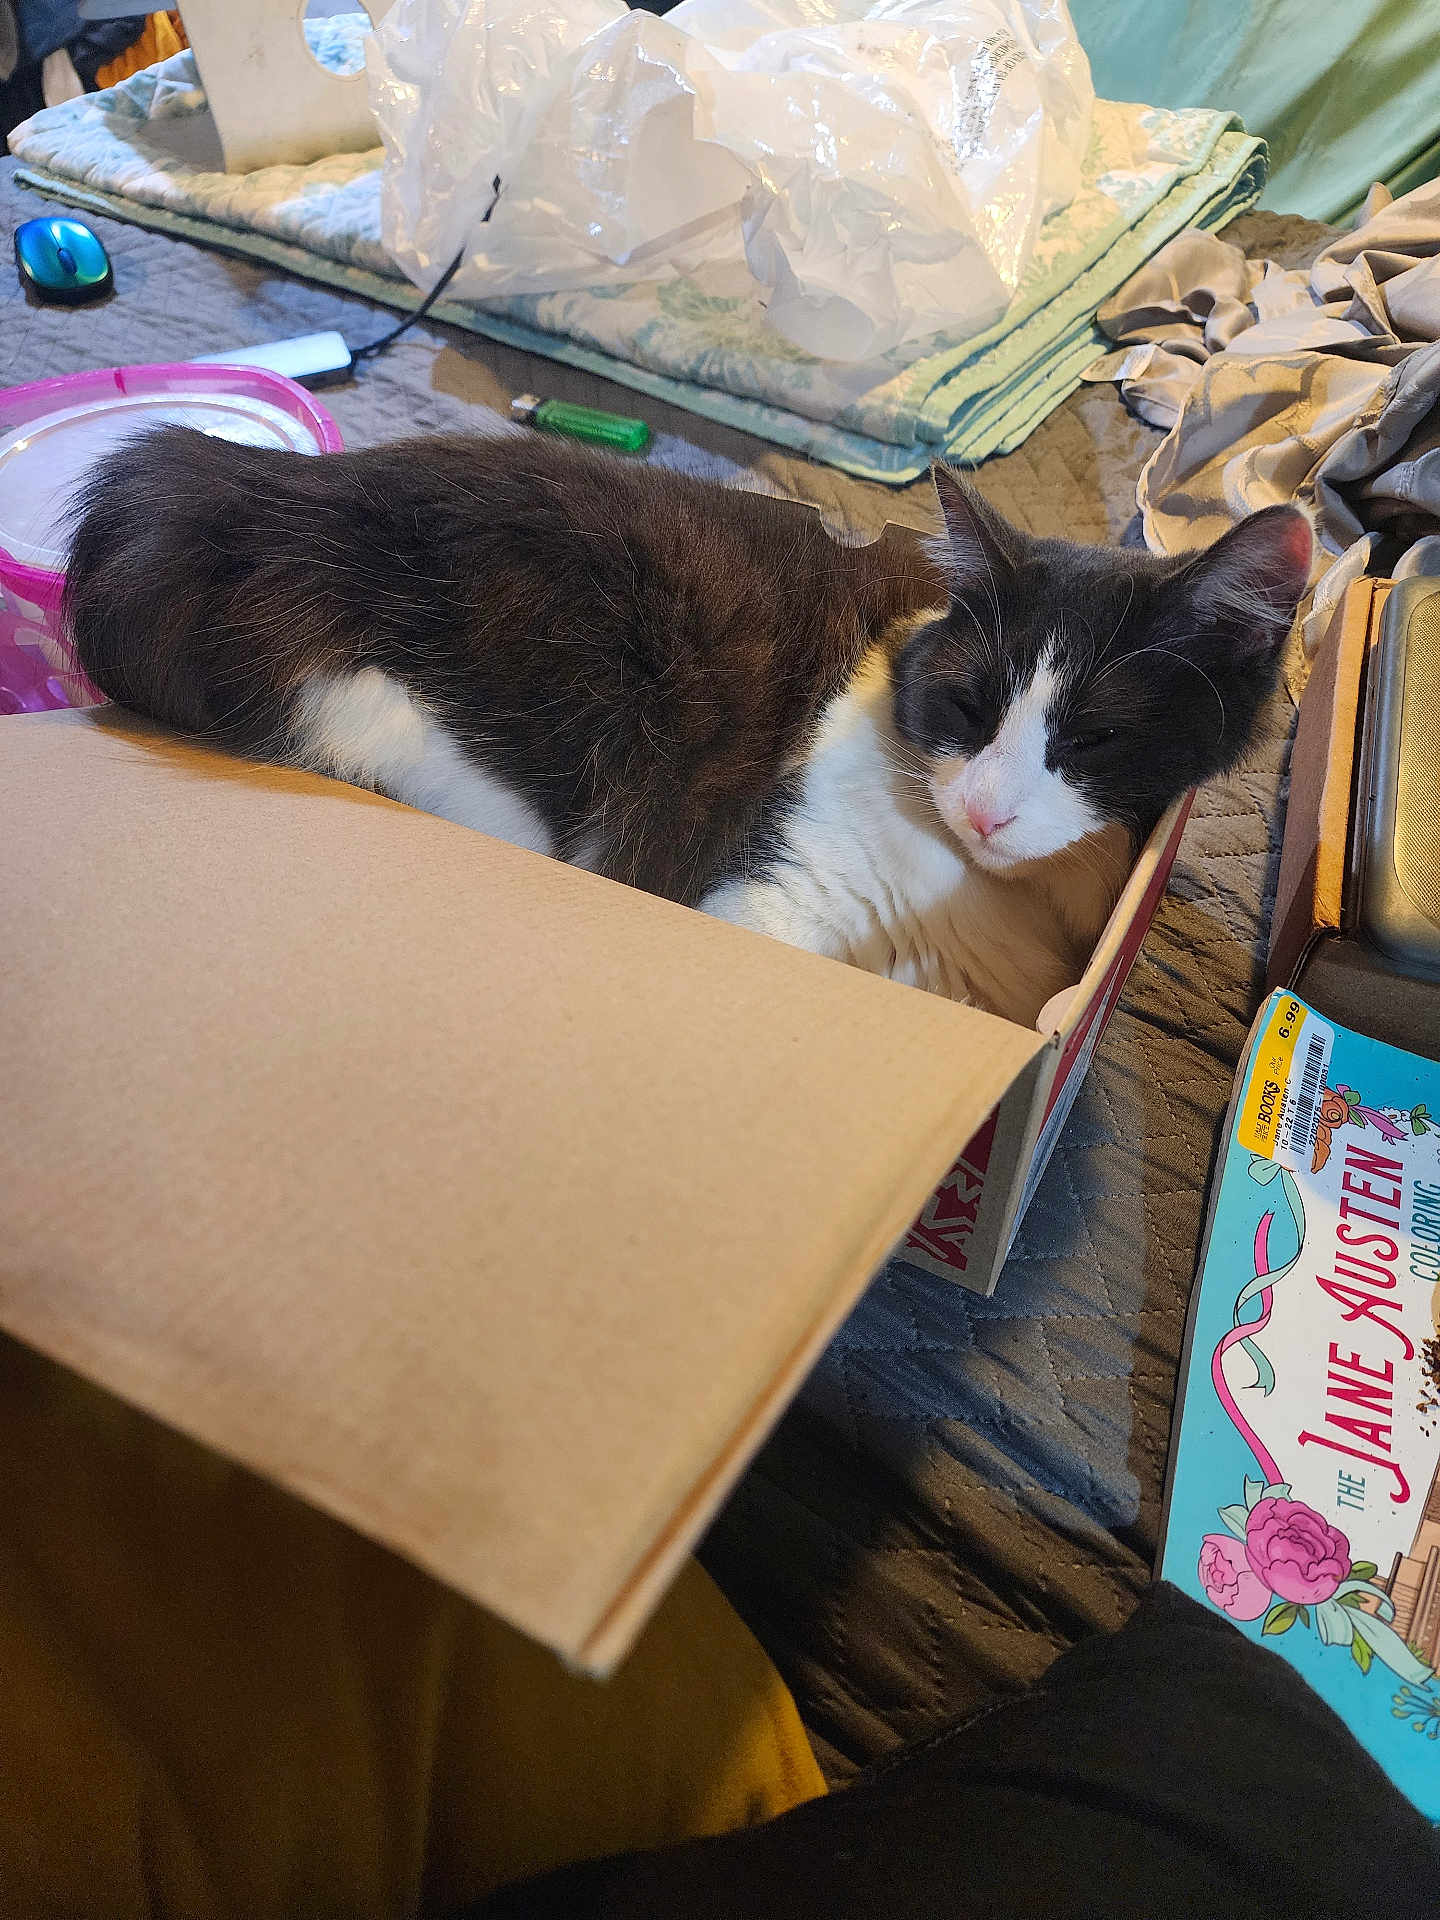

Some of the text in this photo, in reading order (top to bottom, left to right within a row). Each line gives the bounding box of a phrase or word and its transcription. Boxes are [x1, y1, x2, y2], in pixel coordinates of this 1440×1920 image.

[1279, 1001, 1301, 1039] 6.99
[1257, 1080, 1281, 1126] BOOKS
[1277, 1088, 1290, 1121] Austen
[1273, 1122, 1283, 1147] Jane
[1409, 1179, 1440, 1283] COLORING
[1298, 1143, 1415, 1512] THE JANE AUSTEN
